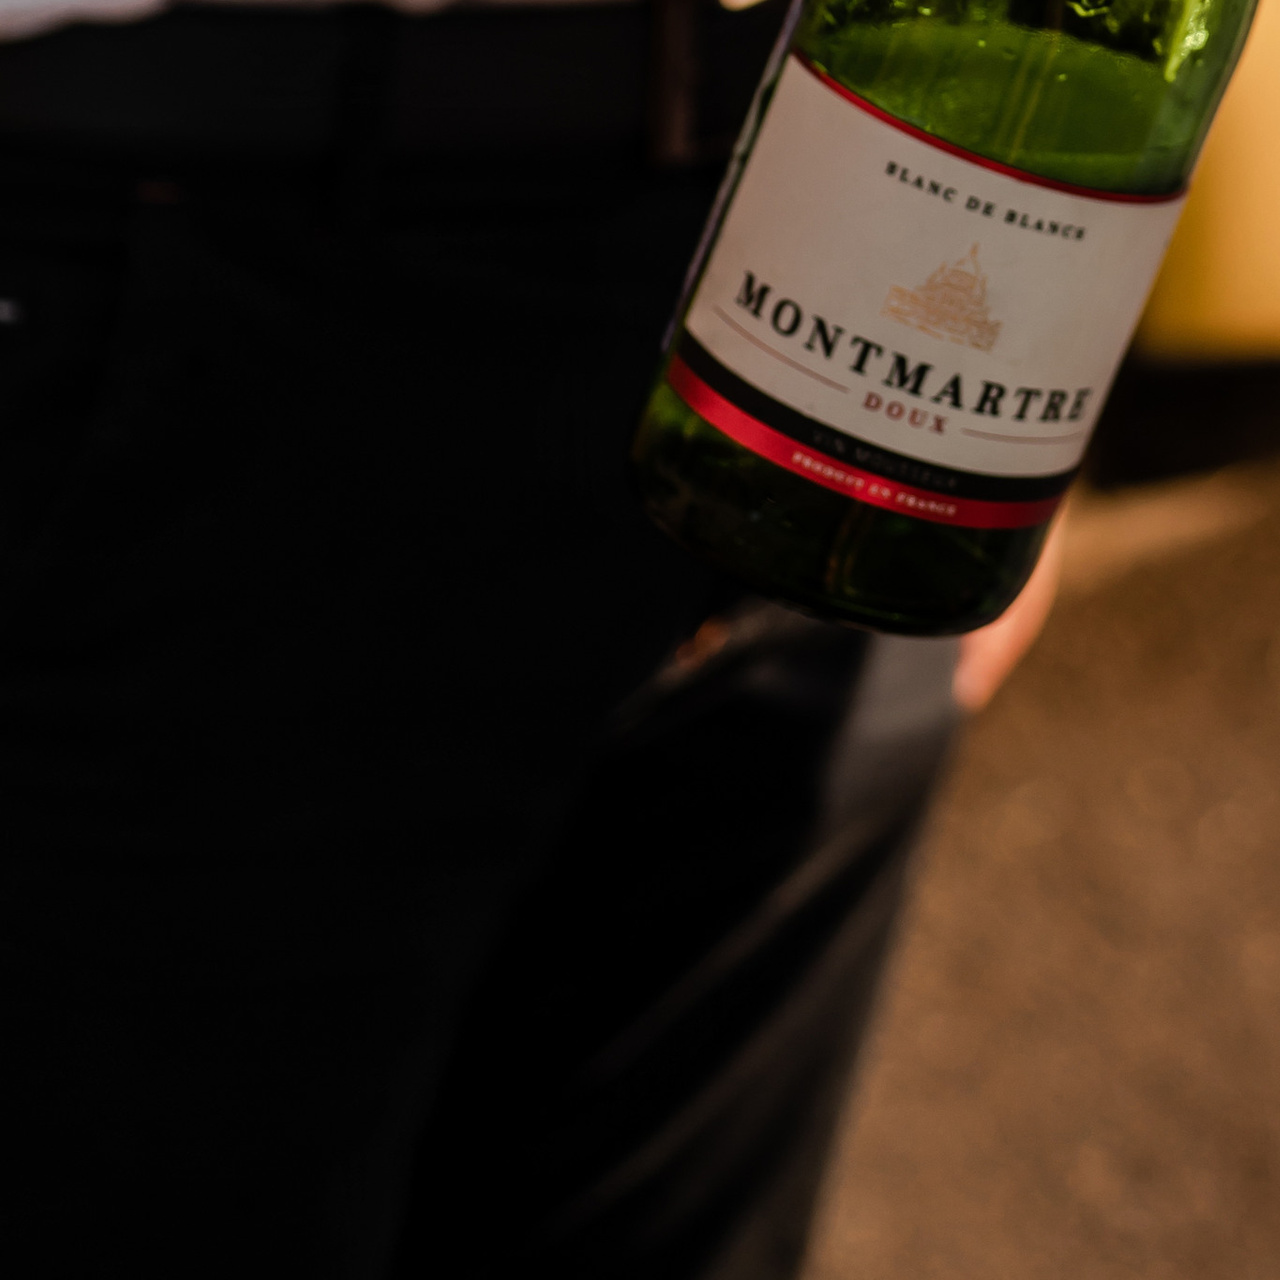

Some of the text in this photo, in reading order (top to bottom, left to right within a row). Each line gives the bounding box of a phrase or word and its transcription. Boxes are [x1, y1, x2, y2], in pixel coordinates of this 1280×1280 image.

[884, 161, 958, 203] BLANC
[965, 195, 996, 217] DE
[735, 270, 1094, 424] MONTMARTRE
[863, 392, 948, 436] DOUX
[895, 491, 957, 517] FRANCE
